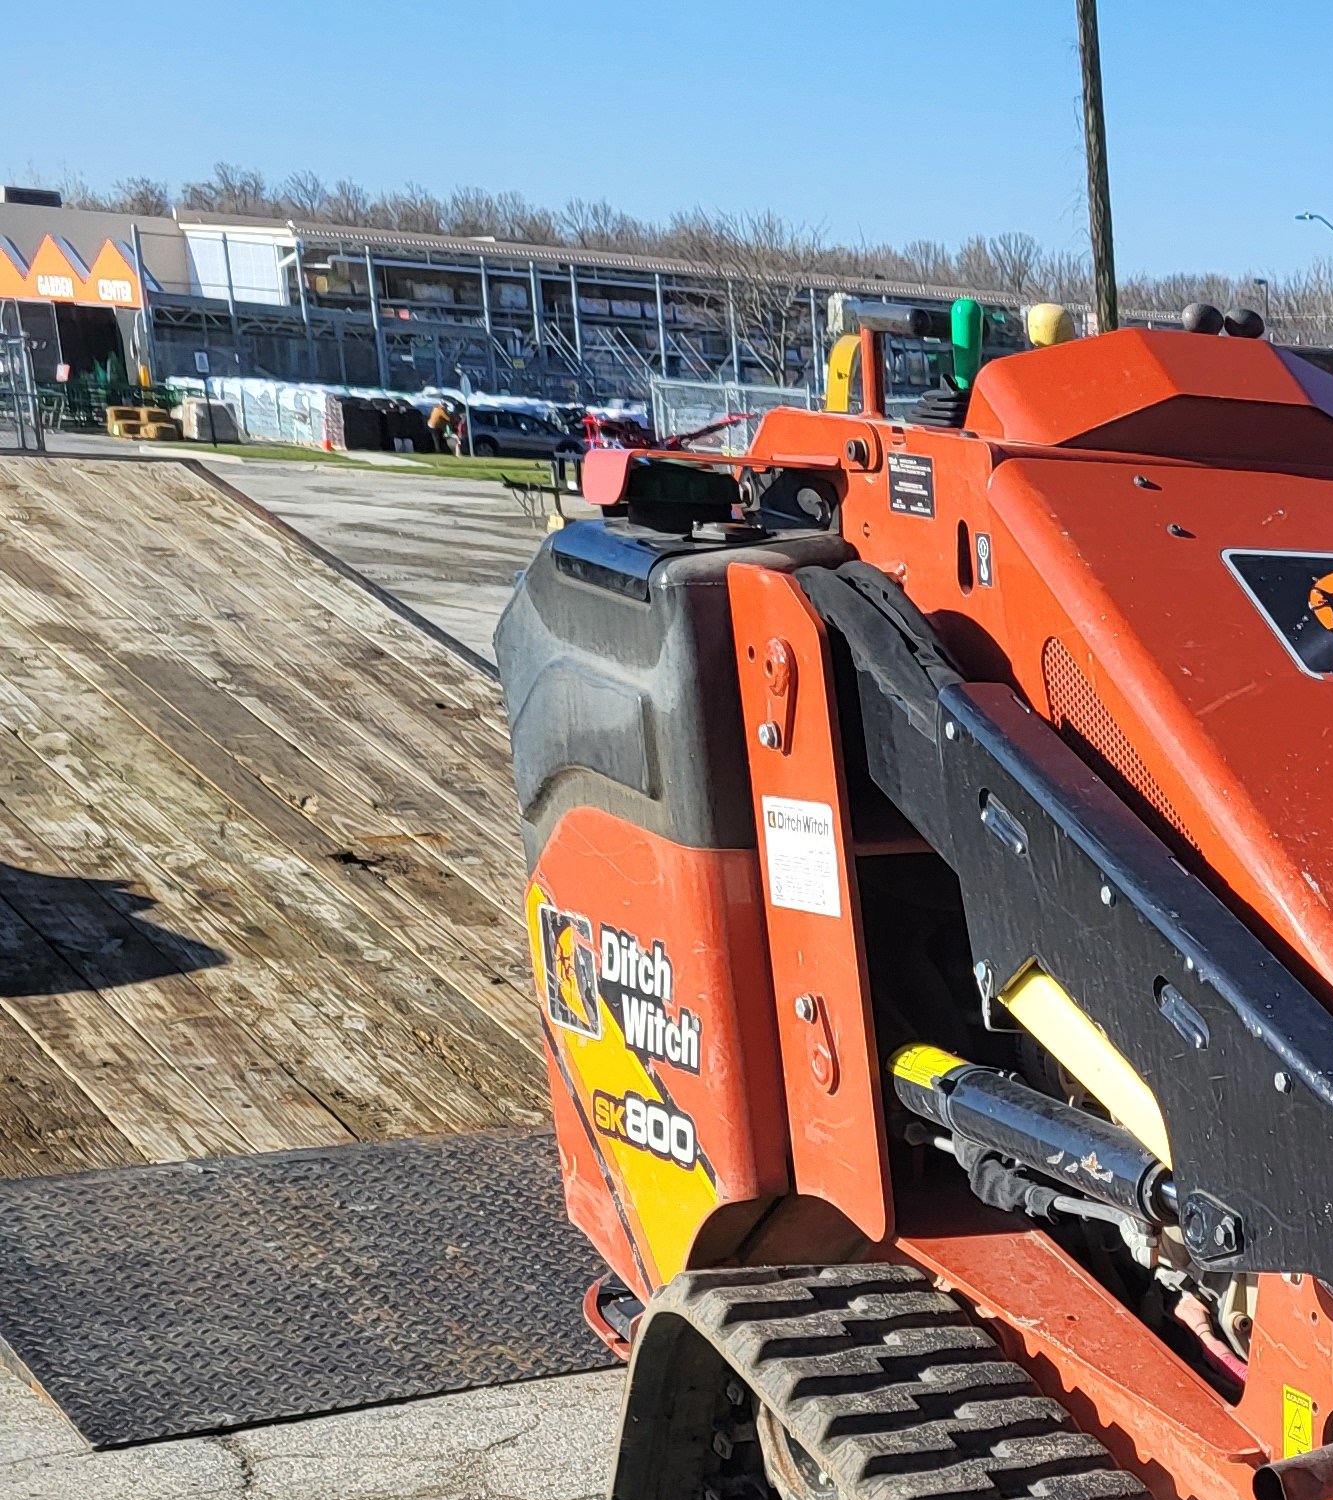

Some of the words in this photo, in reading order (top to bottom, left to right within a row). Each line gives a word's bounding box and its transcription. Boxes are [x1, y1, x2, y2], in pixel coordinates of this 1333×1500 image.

[37, 275, 75, 298] GARDEN
[98, 279, 133, 303] CENTER
[777, 811, 802, 833] Ditch
[802, 815, 829, 837] Witch
[601, 929, 672, 1001] Ditch
[621, 993, 699, 1069] Witch
[595, 1096, 694, 1165] SK800
